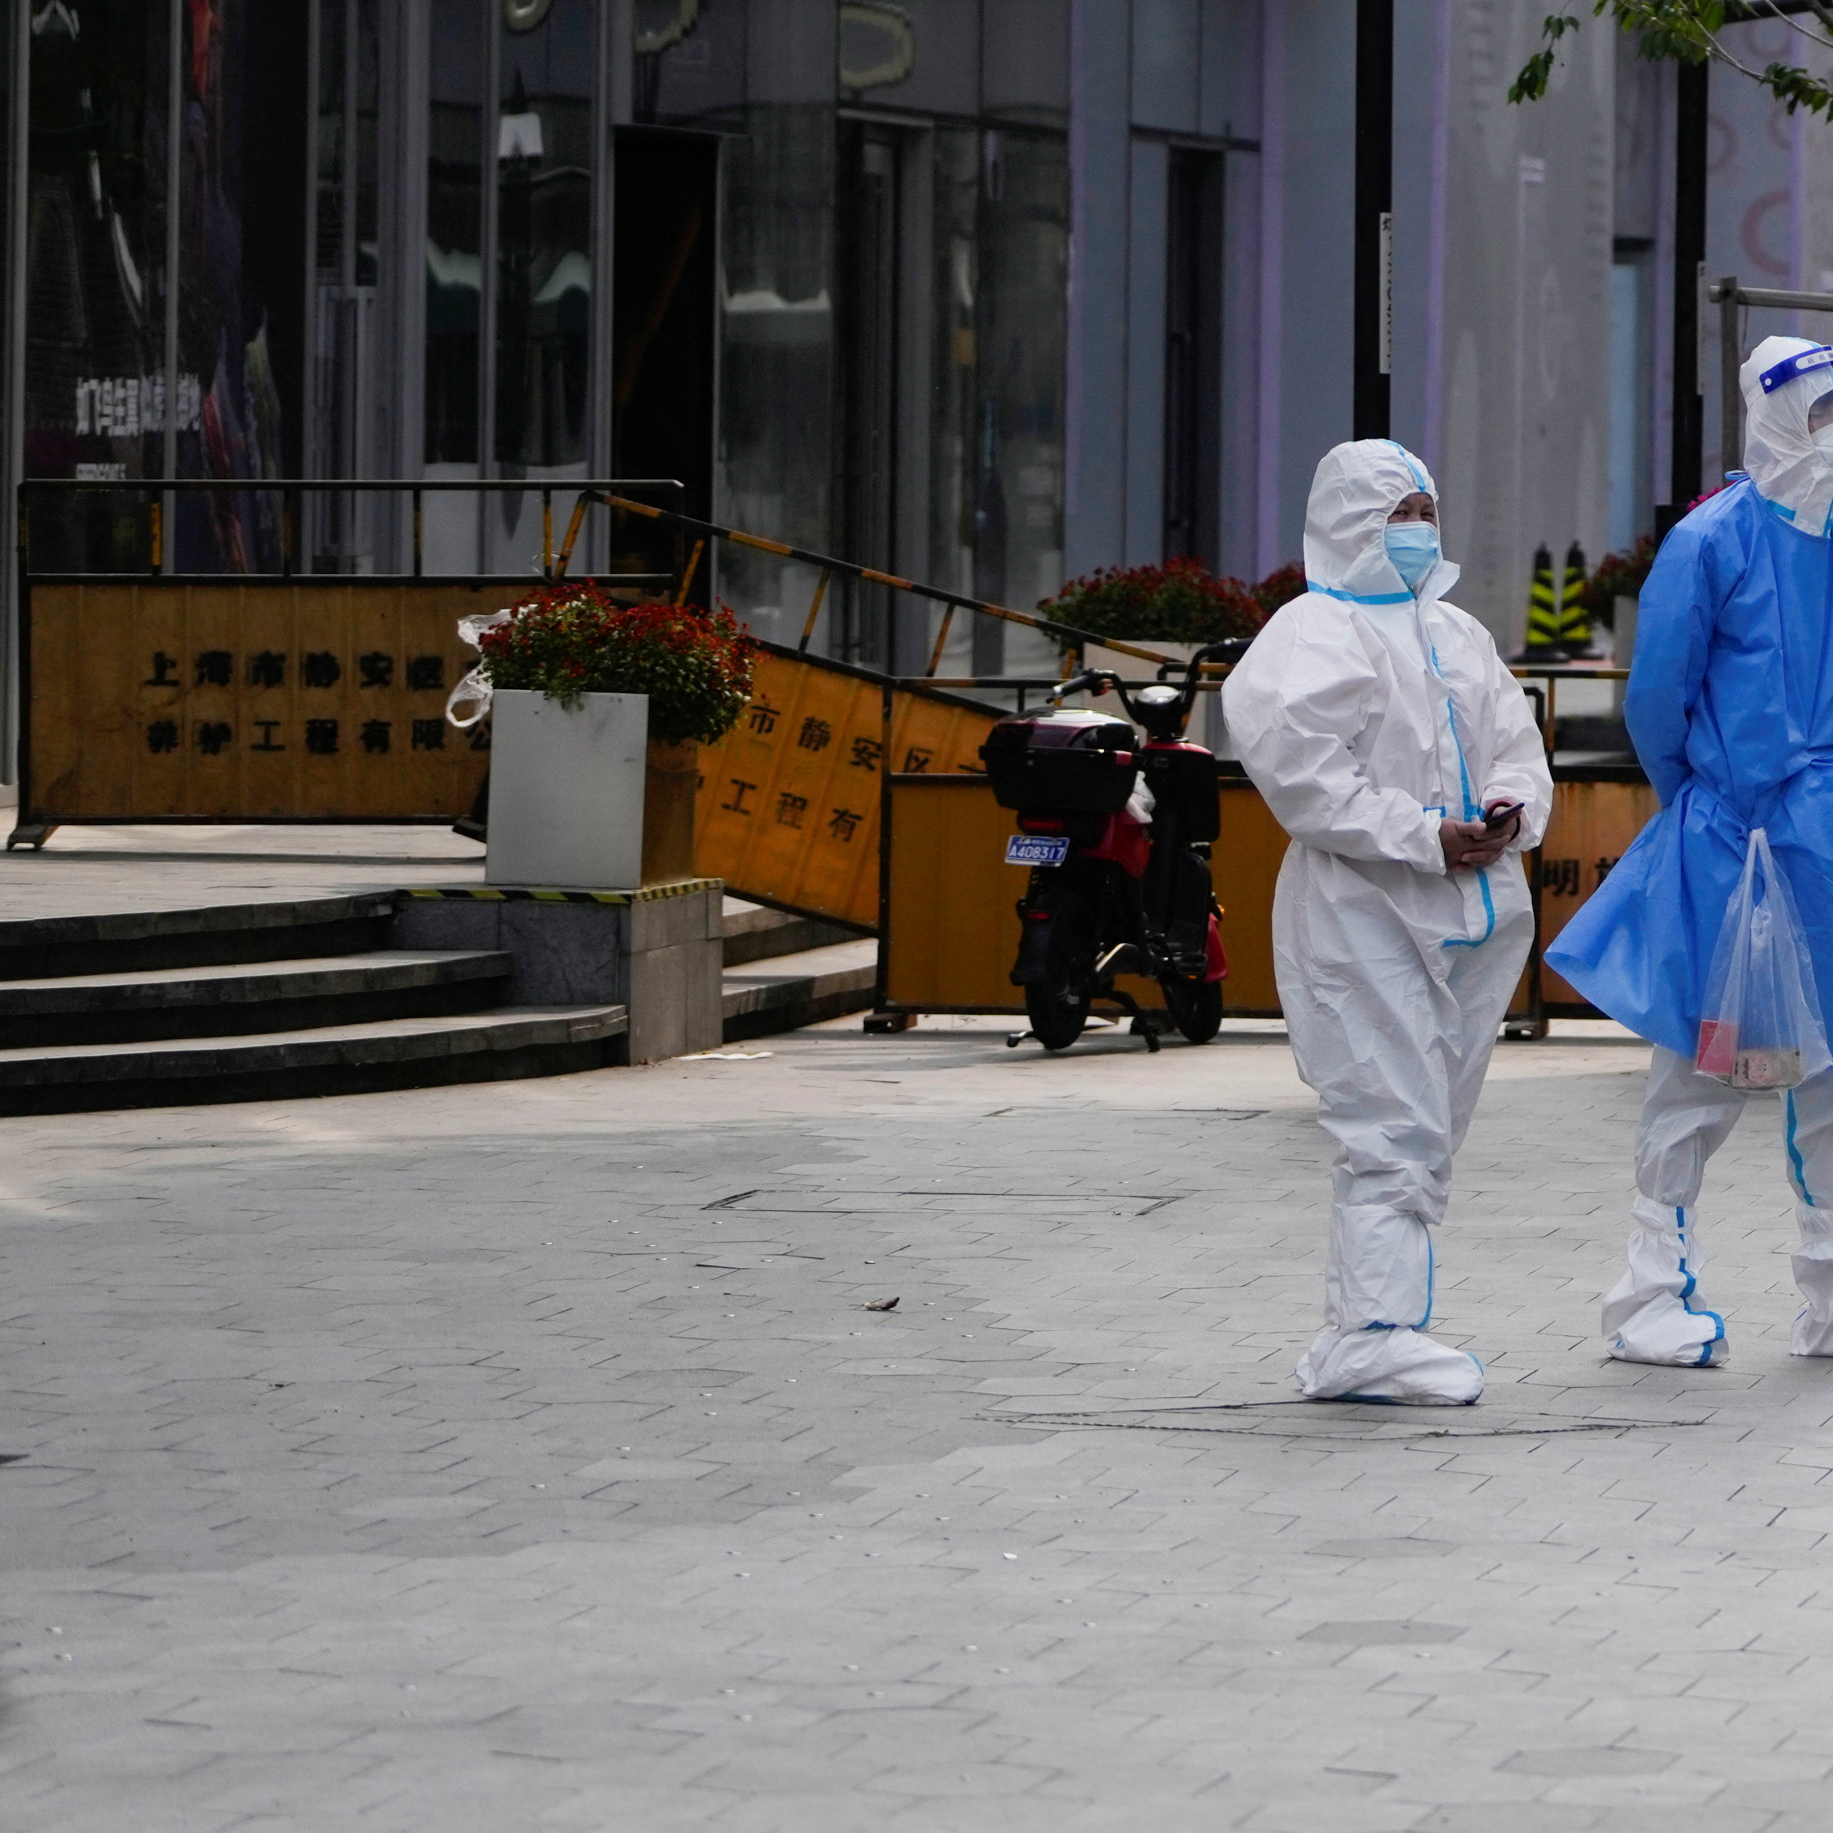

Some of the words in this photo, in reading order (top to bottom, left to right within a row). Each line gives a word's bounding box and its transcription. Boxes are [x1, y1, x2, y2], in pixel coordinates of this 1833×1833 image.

[144, 650, 482, 691] 上海市静安区
[749, 701, 987, 773] 市静安区
[699, 775, 863, 843] 工程有
